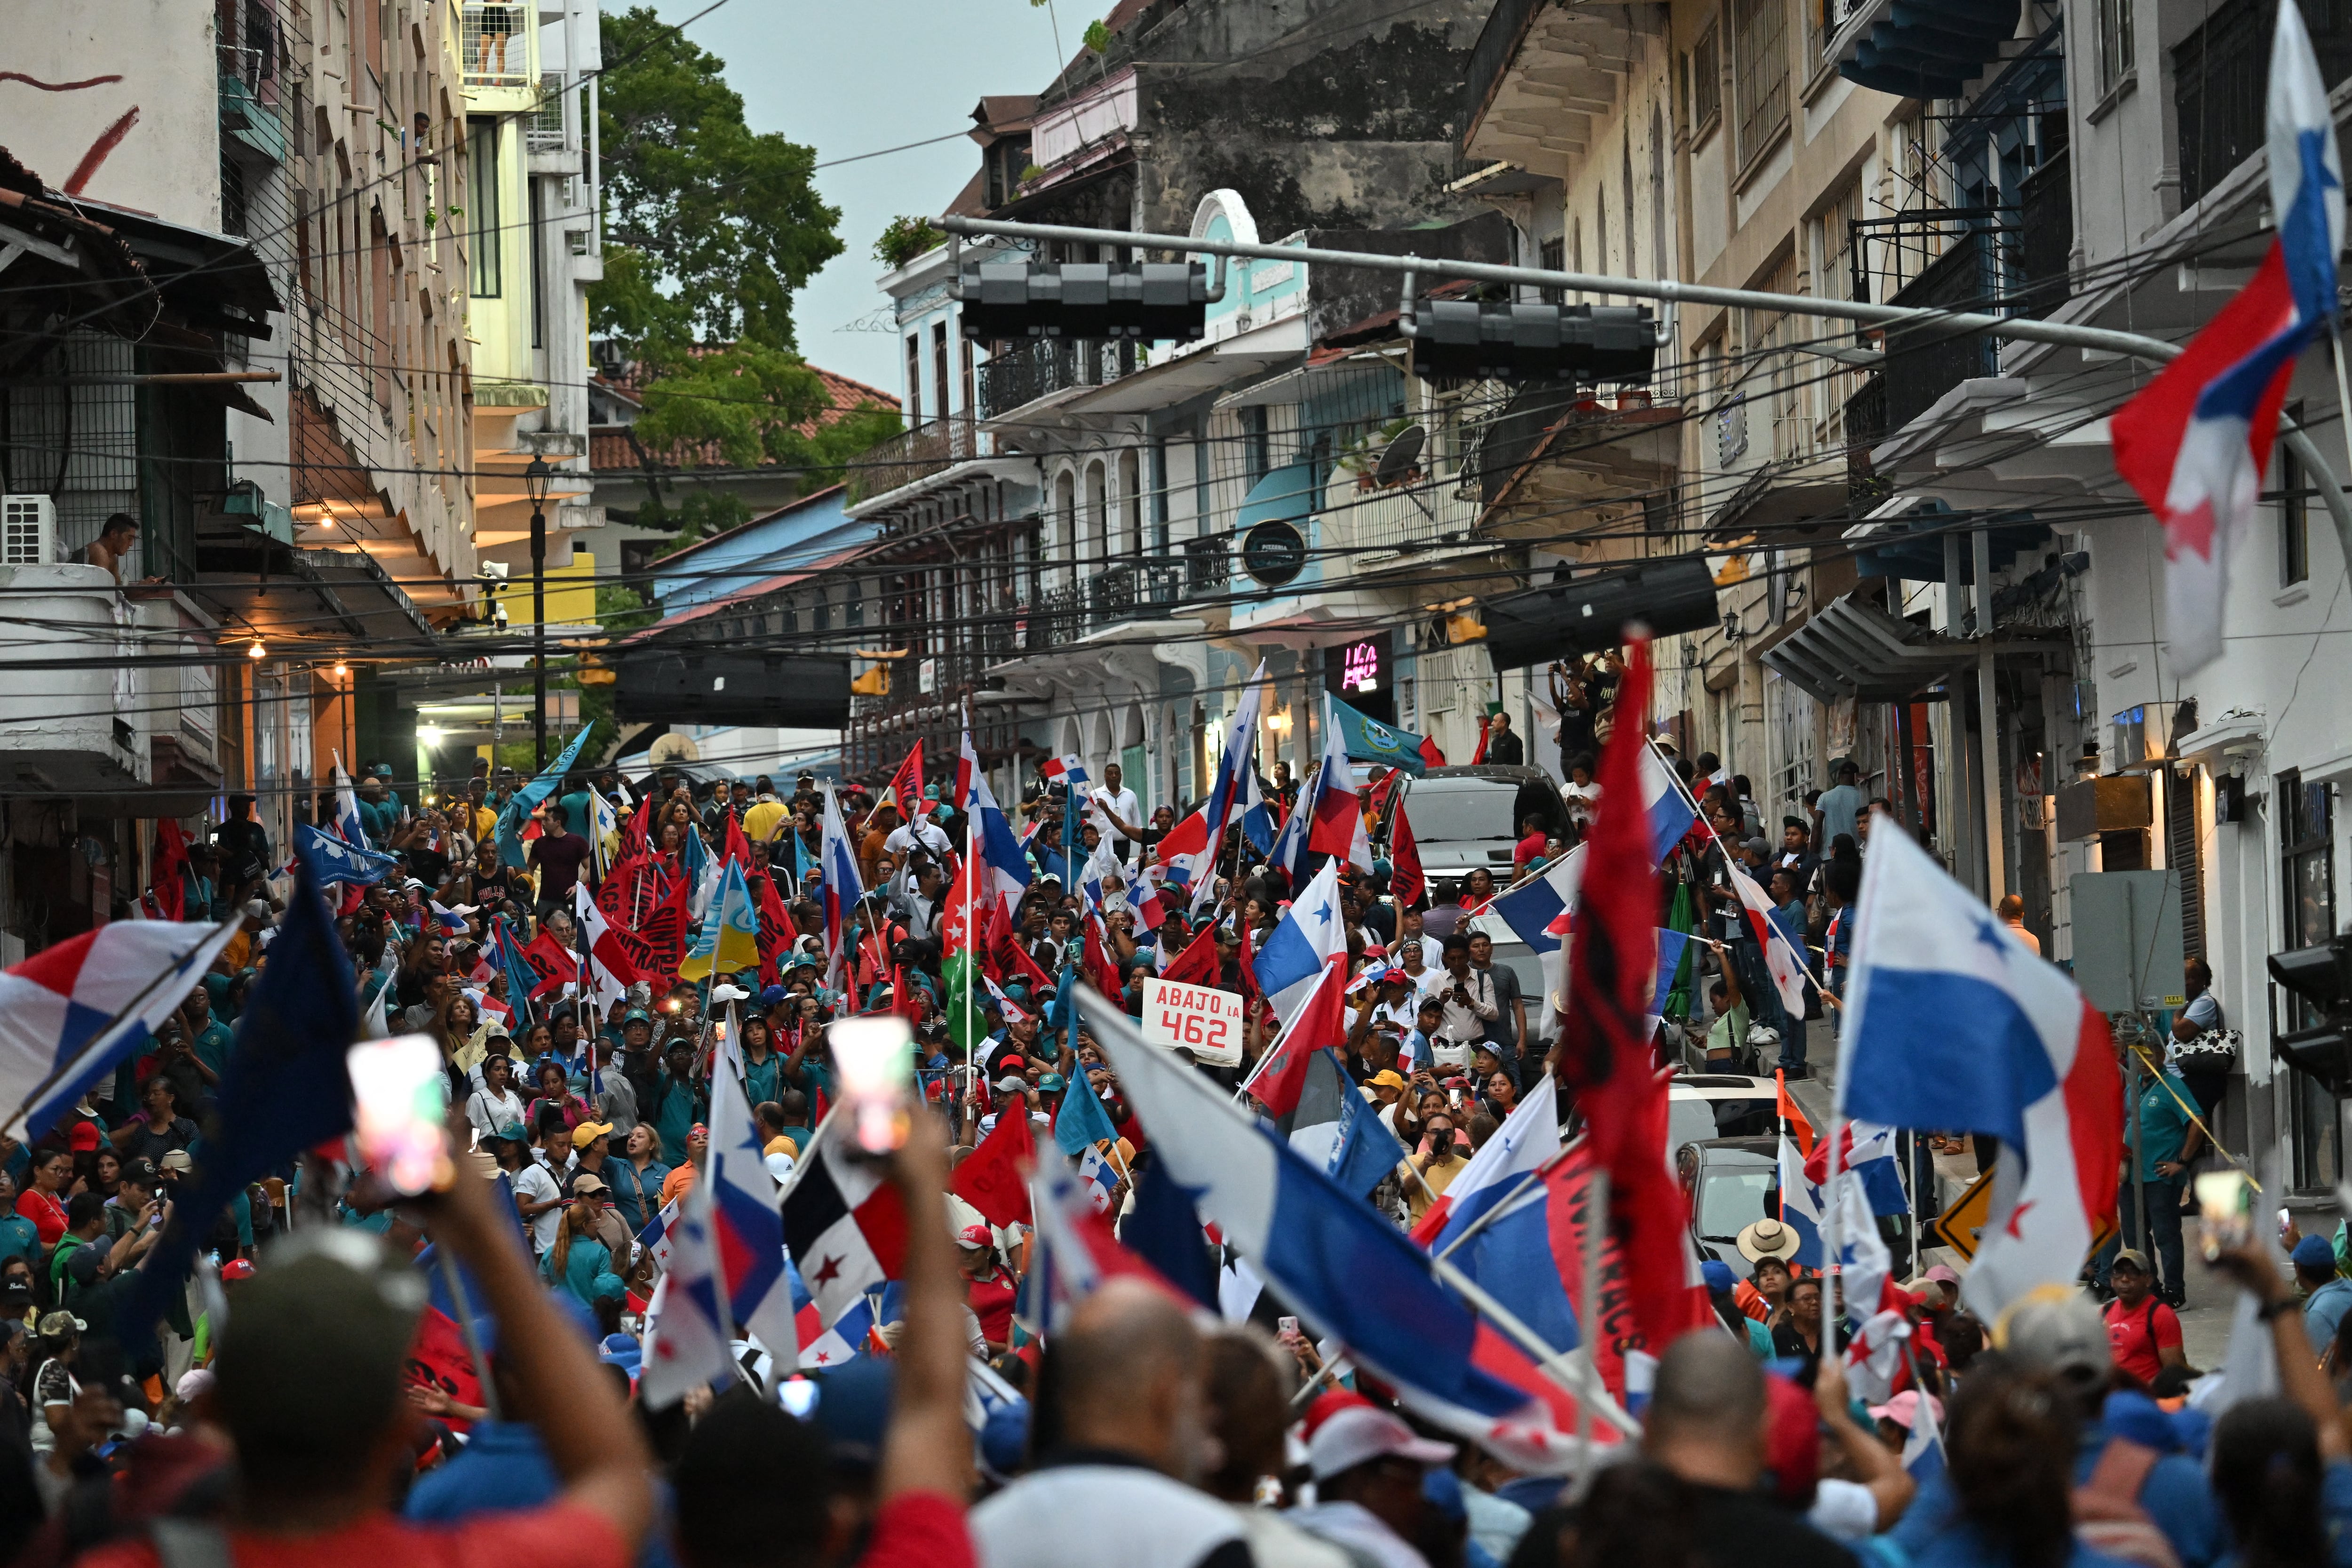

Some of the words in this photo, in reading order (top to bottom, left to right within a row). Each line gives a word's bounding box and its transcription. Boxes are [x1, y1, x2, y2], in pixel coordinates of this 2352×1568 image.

[477, 885, 506, 904] BULLS
[1156, 986, 1221, 1013] ABAJO
[1227, 1005, 1240, 1018] LA
[1161, 1011, 1228, 1049] 462
